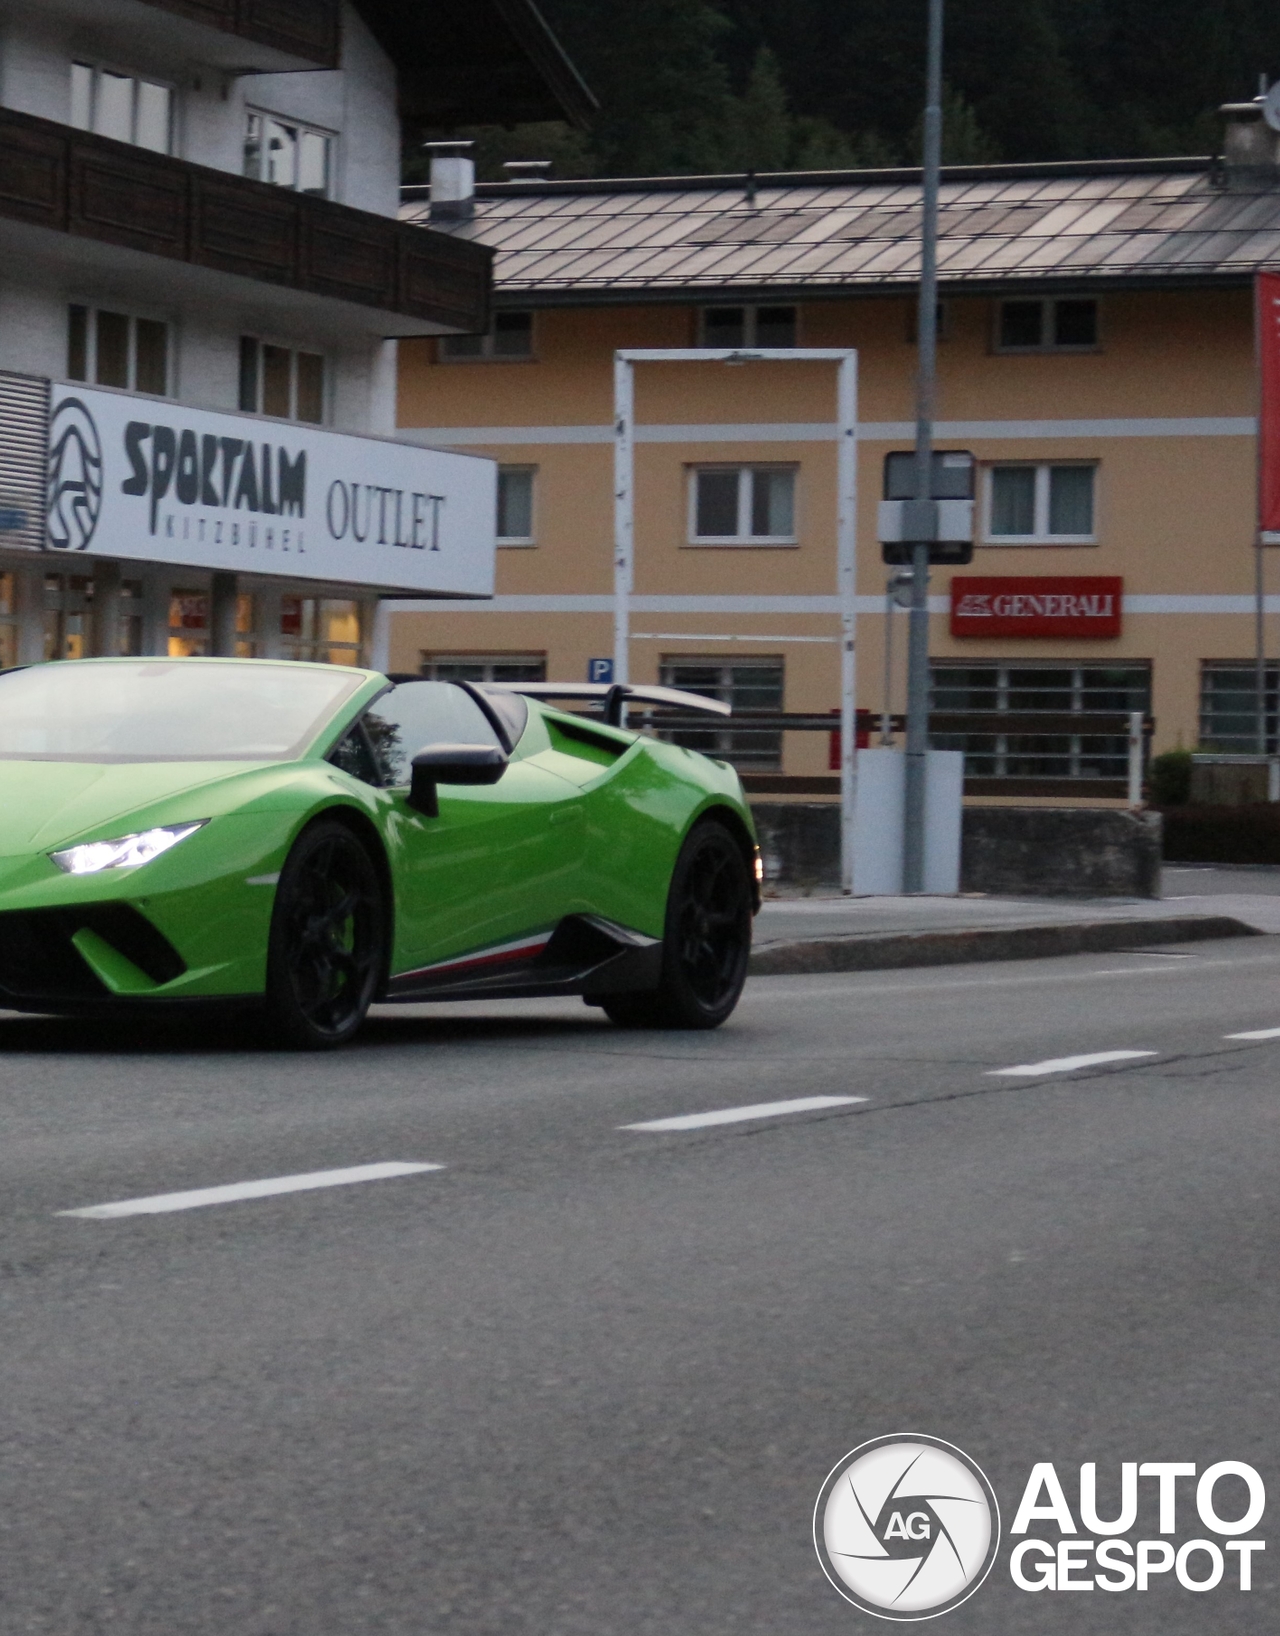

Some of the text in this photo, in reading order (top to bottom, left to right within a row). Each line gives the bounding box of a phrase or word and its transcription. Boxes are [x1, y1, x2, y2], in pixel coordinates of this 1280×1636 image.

[121, 420, 308, 535] SPORTALM
[165, 513, 307, 554] KITZBÜHEL
[326, 479, 446, 552] OUTLET
[993, 594, 1114, 617] GENERALI
[593, 660, 610, 681] P
